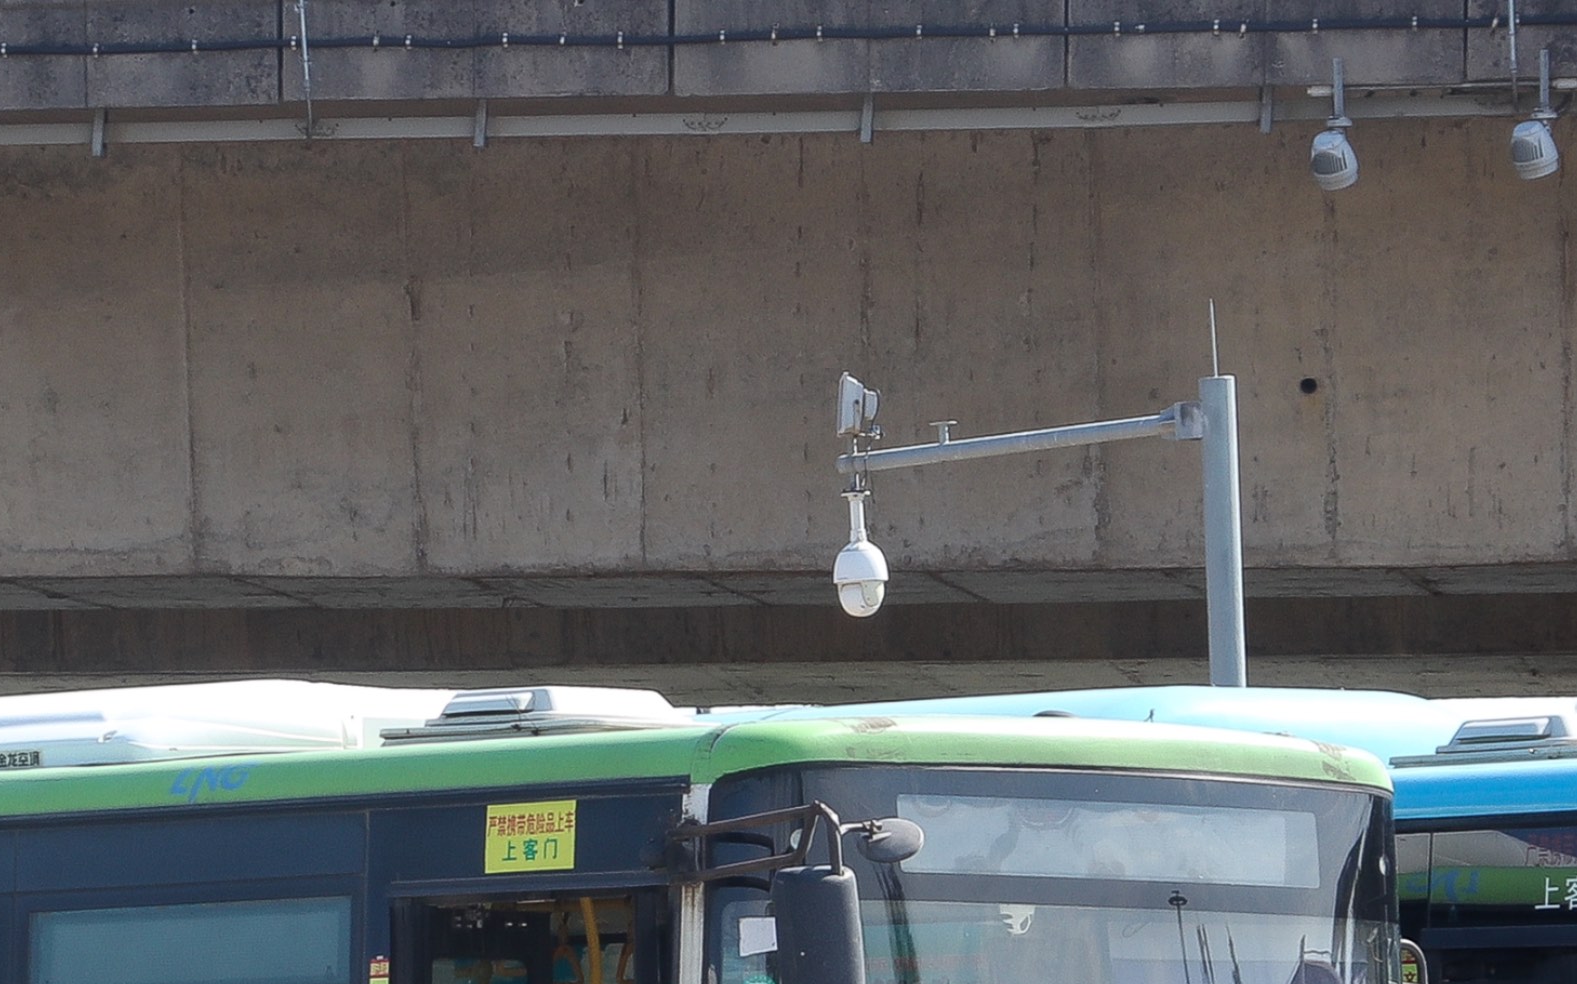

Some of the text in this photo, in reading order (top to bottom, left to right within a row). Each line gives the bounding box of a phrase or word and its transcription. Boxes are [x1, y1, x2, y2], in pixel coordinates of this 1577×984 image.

[488, 811, 574, 837] 严禁携带危险品上车
[501, 838, 559, 861] 上客门
